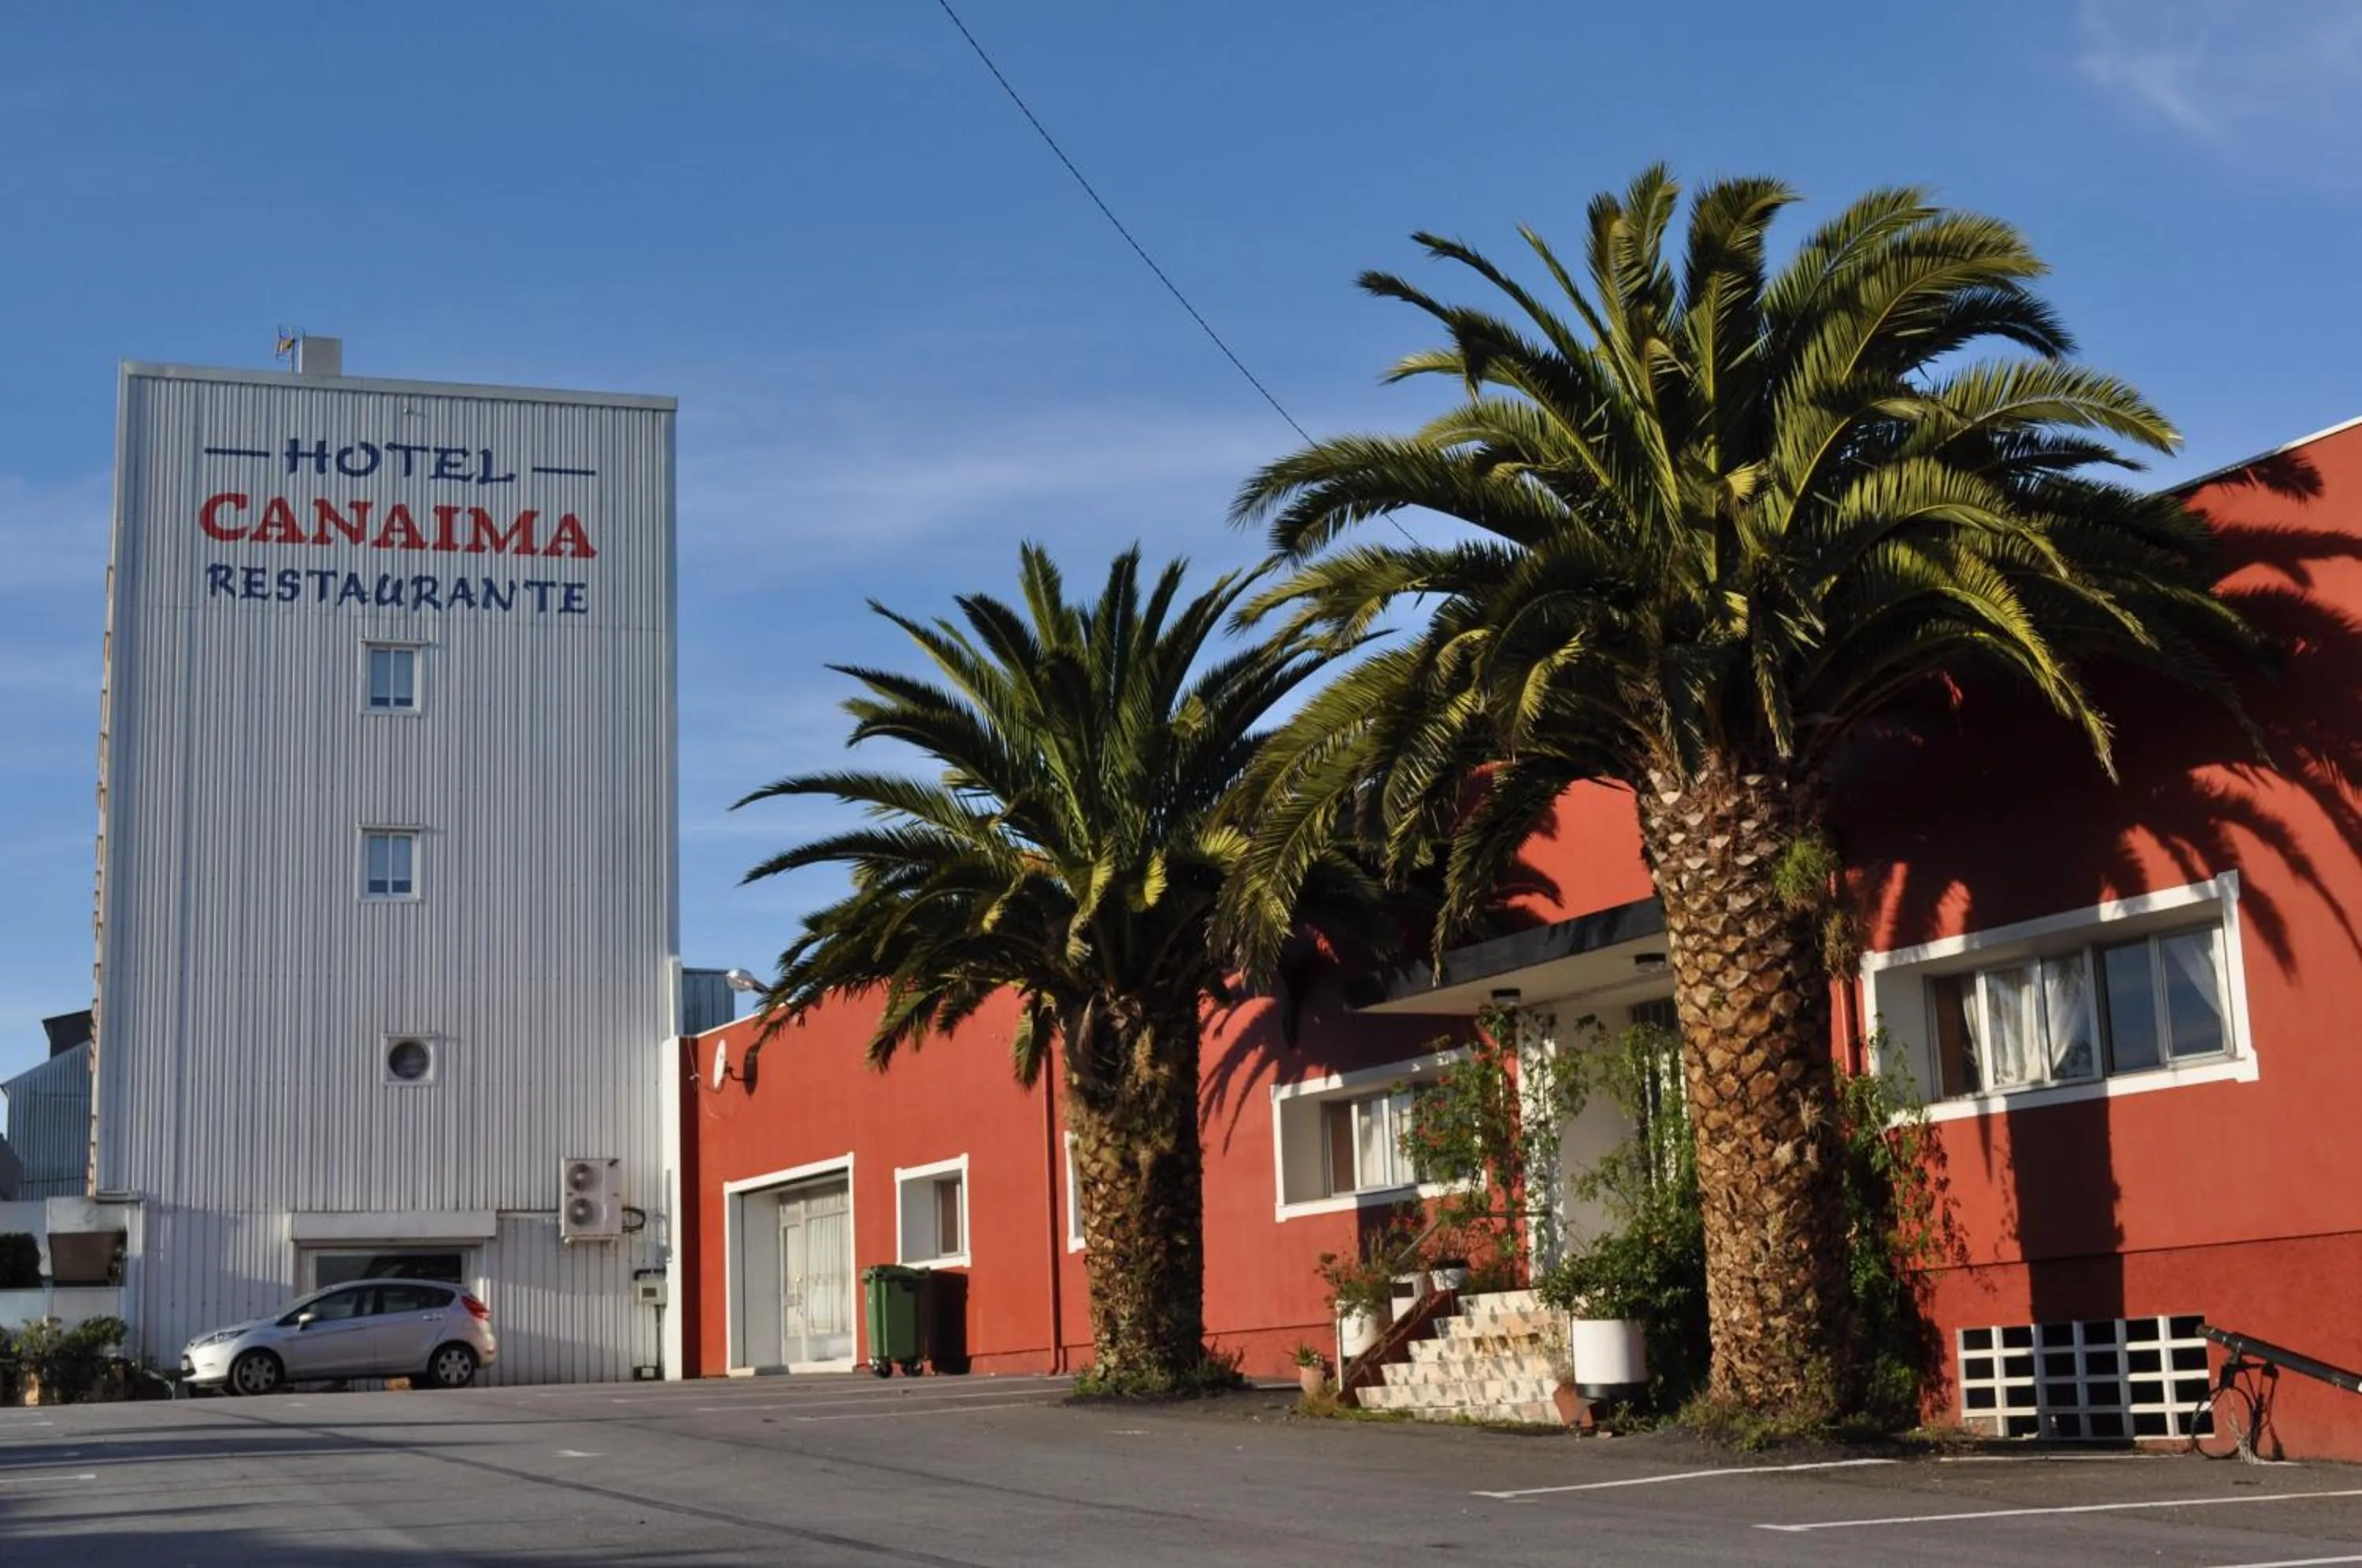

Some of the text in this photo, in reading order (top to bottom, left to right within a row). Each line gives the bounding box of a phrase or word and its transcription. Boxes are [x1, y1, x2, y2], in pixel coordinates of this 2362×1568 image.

[284, 438, 516, 485] HOTEL
[199, 493, 598, 559] CANAIMA
[205, 563, 589, 614] RESTAURANTE
